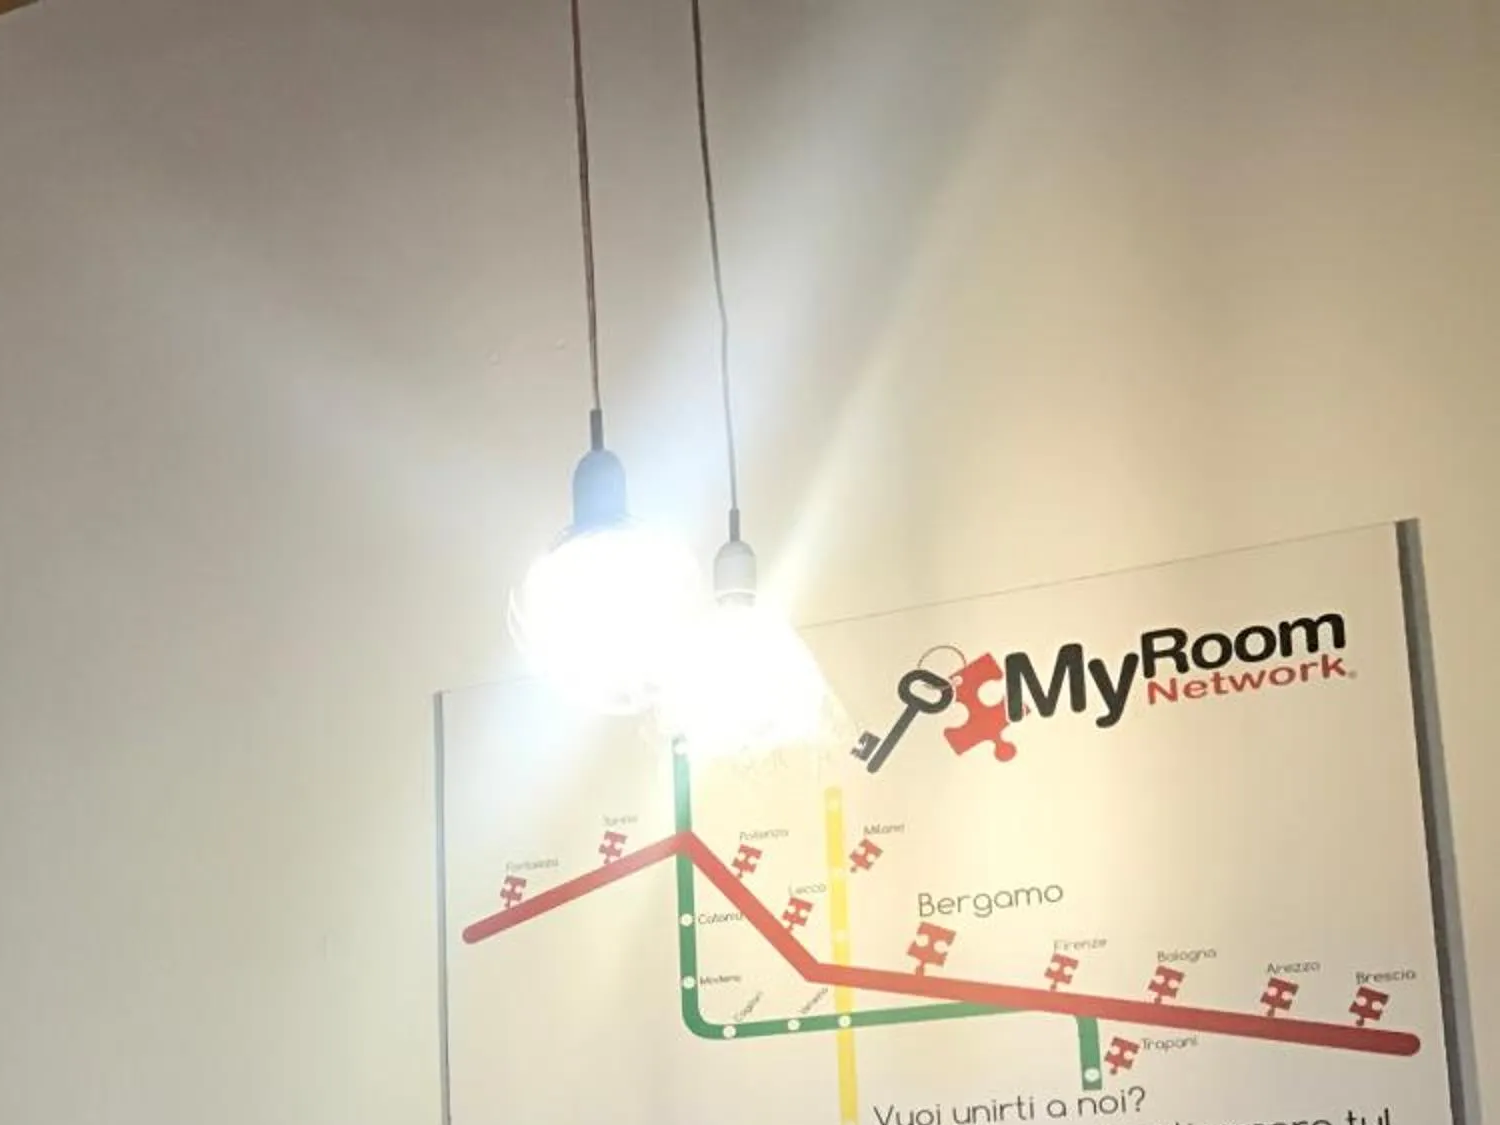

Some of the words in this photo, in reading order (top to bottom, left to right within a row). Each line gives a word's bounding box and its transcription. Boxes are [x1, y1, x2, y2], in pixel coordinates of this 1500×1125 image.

[1004, 612, 1347, 728] MyRoom
[1148, 653, 1346, 705] Network
[917, 883, 1064, 920] Bergamo
[1053, 937, 1108, 951] Firenze
[1156, 947, 1217, 963] Bologna
[1266, 960, 1321, 975] Arezzo
[1355, 968, 1416, 985] Brescia
[1141, 1034, 1198, 1053] Trapani
[952, 1094, 1035, 1125] unirti
[1046, 1099, 1068, 1119] a
[1076, 1086, 1147, 1115] noi?
